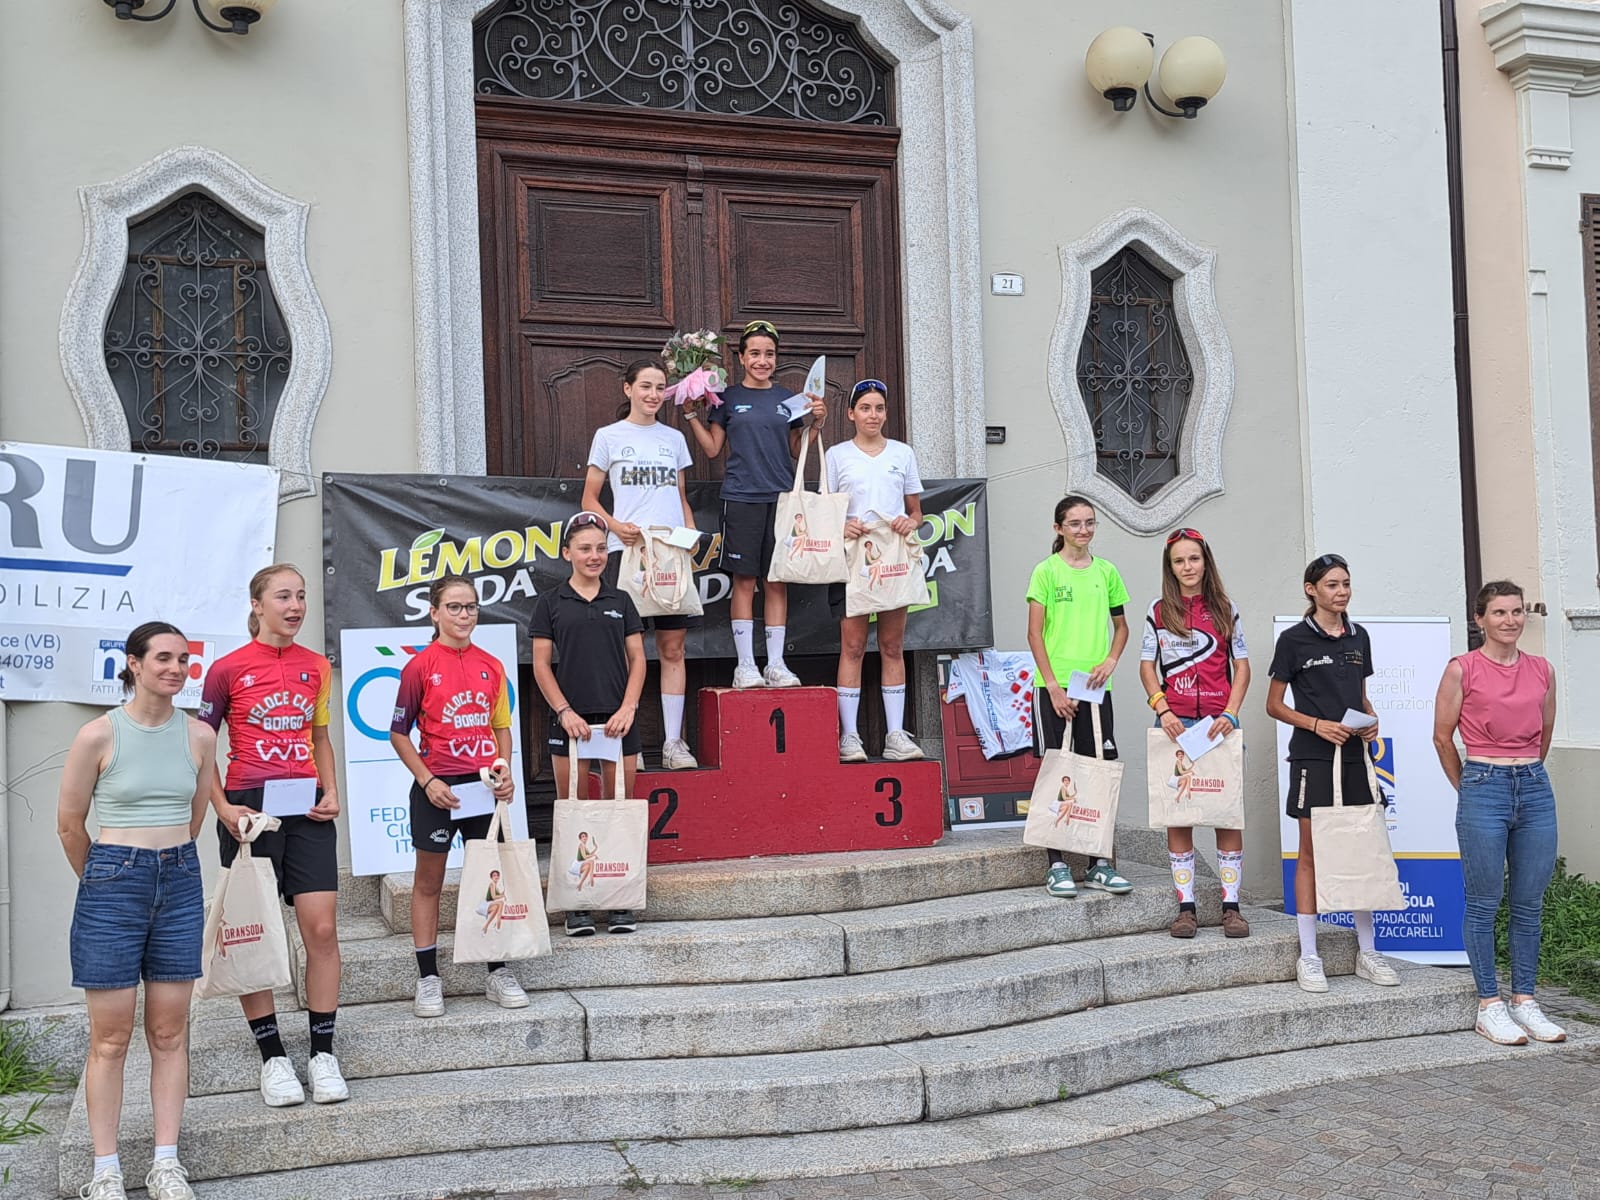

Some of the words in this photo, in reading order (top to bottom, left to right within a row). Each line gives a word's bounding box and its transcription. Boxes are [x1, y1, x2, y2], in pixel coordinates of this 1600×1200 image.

[1002, 278, 1013, 289] 21
[377, 521, 563, 592] LEMON
[403, 568, 538, 621] SDA
[25, 633, 61, 653] (VB)
[246, 691, 289, 724] VELOCE
[263, 715, 305, 731] BORGO
[441, 690, 473, 724] VELOCE
[769, 707, 786, 753] 1
[649, 788, 679, 839] 2
[875, 777, 903, 827] 3
[224, 923, 264, 940] ORANSODA
[1379, 926, 1443, 938] ZACCARELLI
